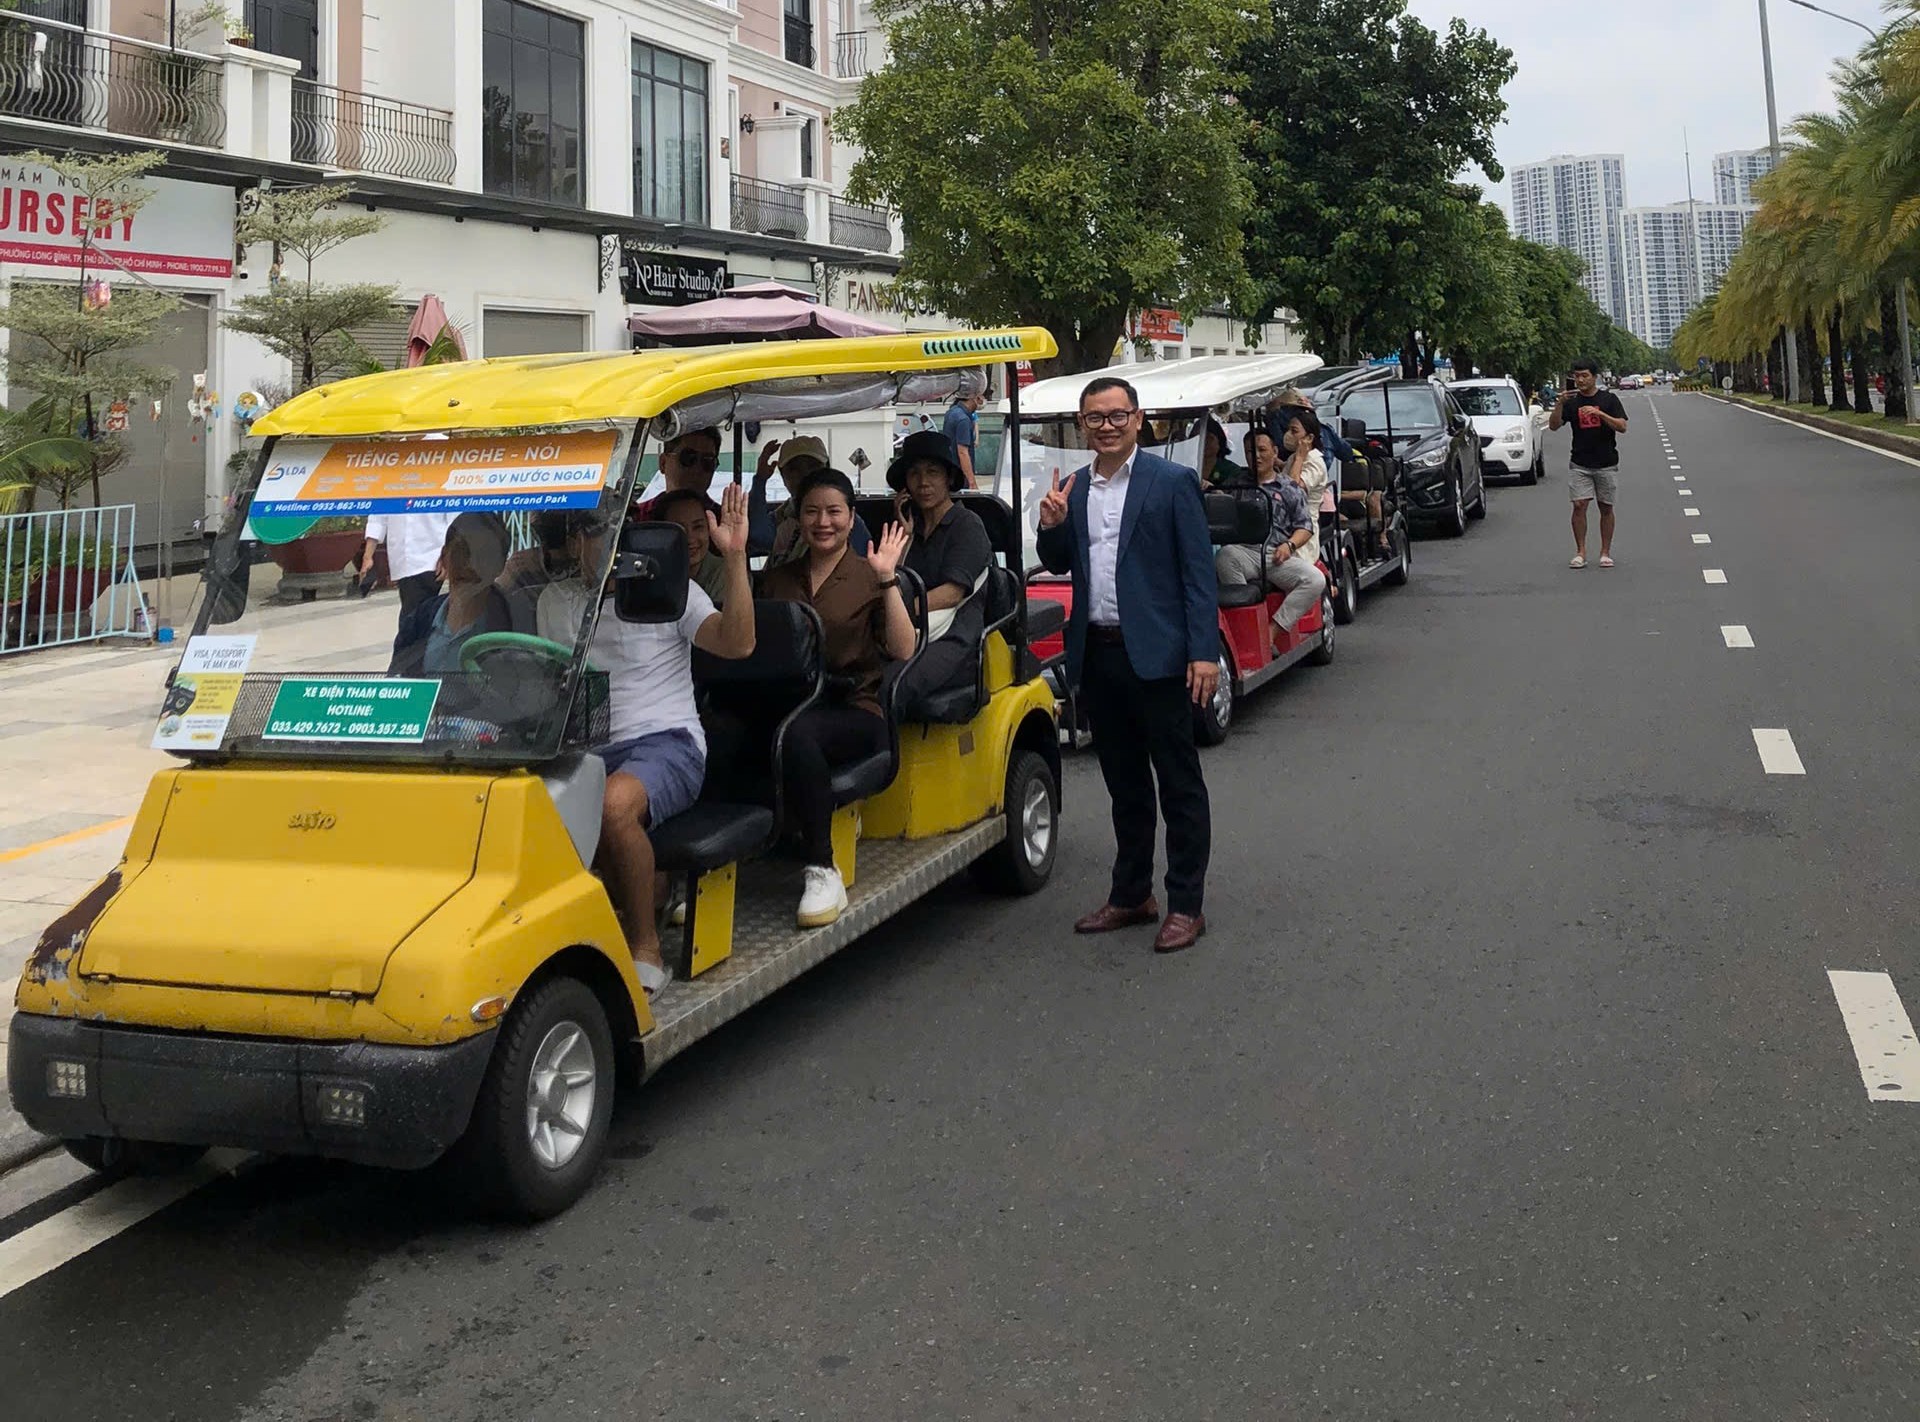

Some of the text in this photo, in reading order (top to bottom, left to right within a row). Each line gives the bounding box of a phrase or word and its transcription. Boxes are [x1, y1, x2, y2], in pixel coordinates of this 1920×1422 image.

[32, 251, 53, 261] LONG
[653, 265, 677, 288] Hair
[680, 267, 711, 291] Studio
[345, 448, 399, 468] TIẾNG
[403, 450, 447, 467] ANH
[451, 448, 506, 465] NGHE
[524, 443, 560, 461] NÓI
[453, 474, 484, 485] 100%
[488, 473, 505, 484] GV
[445, 499, 460, 507] 106
[463, 496, 510, 506] Vinhomes
[513, 496, 543, 505] Grand
[545, 494, 567, 503] Park
[275, 502, 311, 512] Hotline:
[212, 649, 247, 659] PASSPORT
[302, 687, 318, 698] XE
[346, 687, 377, 699] THAM
[378, 687, 411, 699] QUAN
[327, 704, 374, 716] HOTLINE:
[271, 721, 341, 733] 033.429.7672
